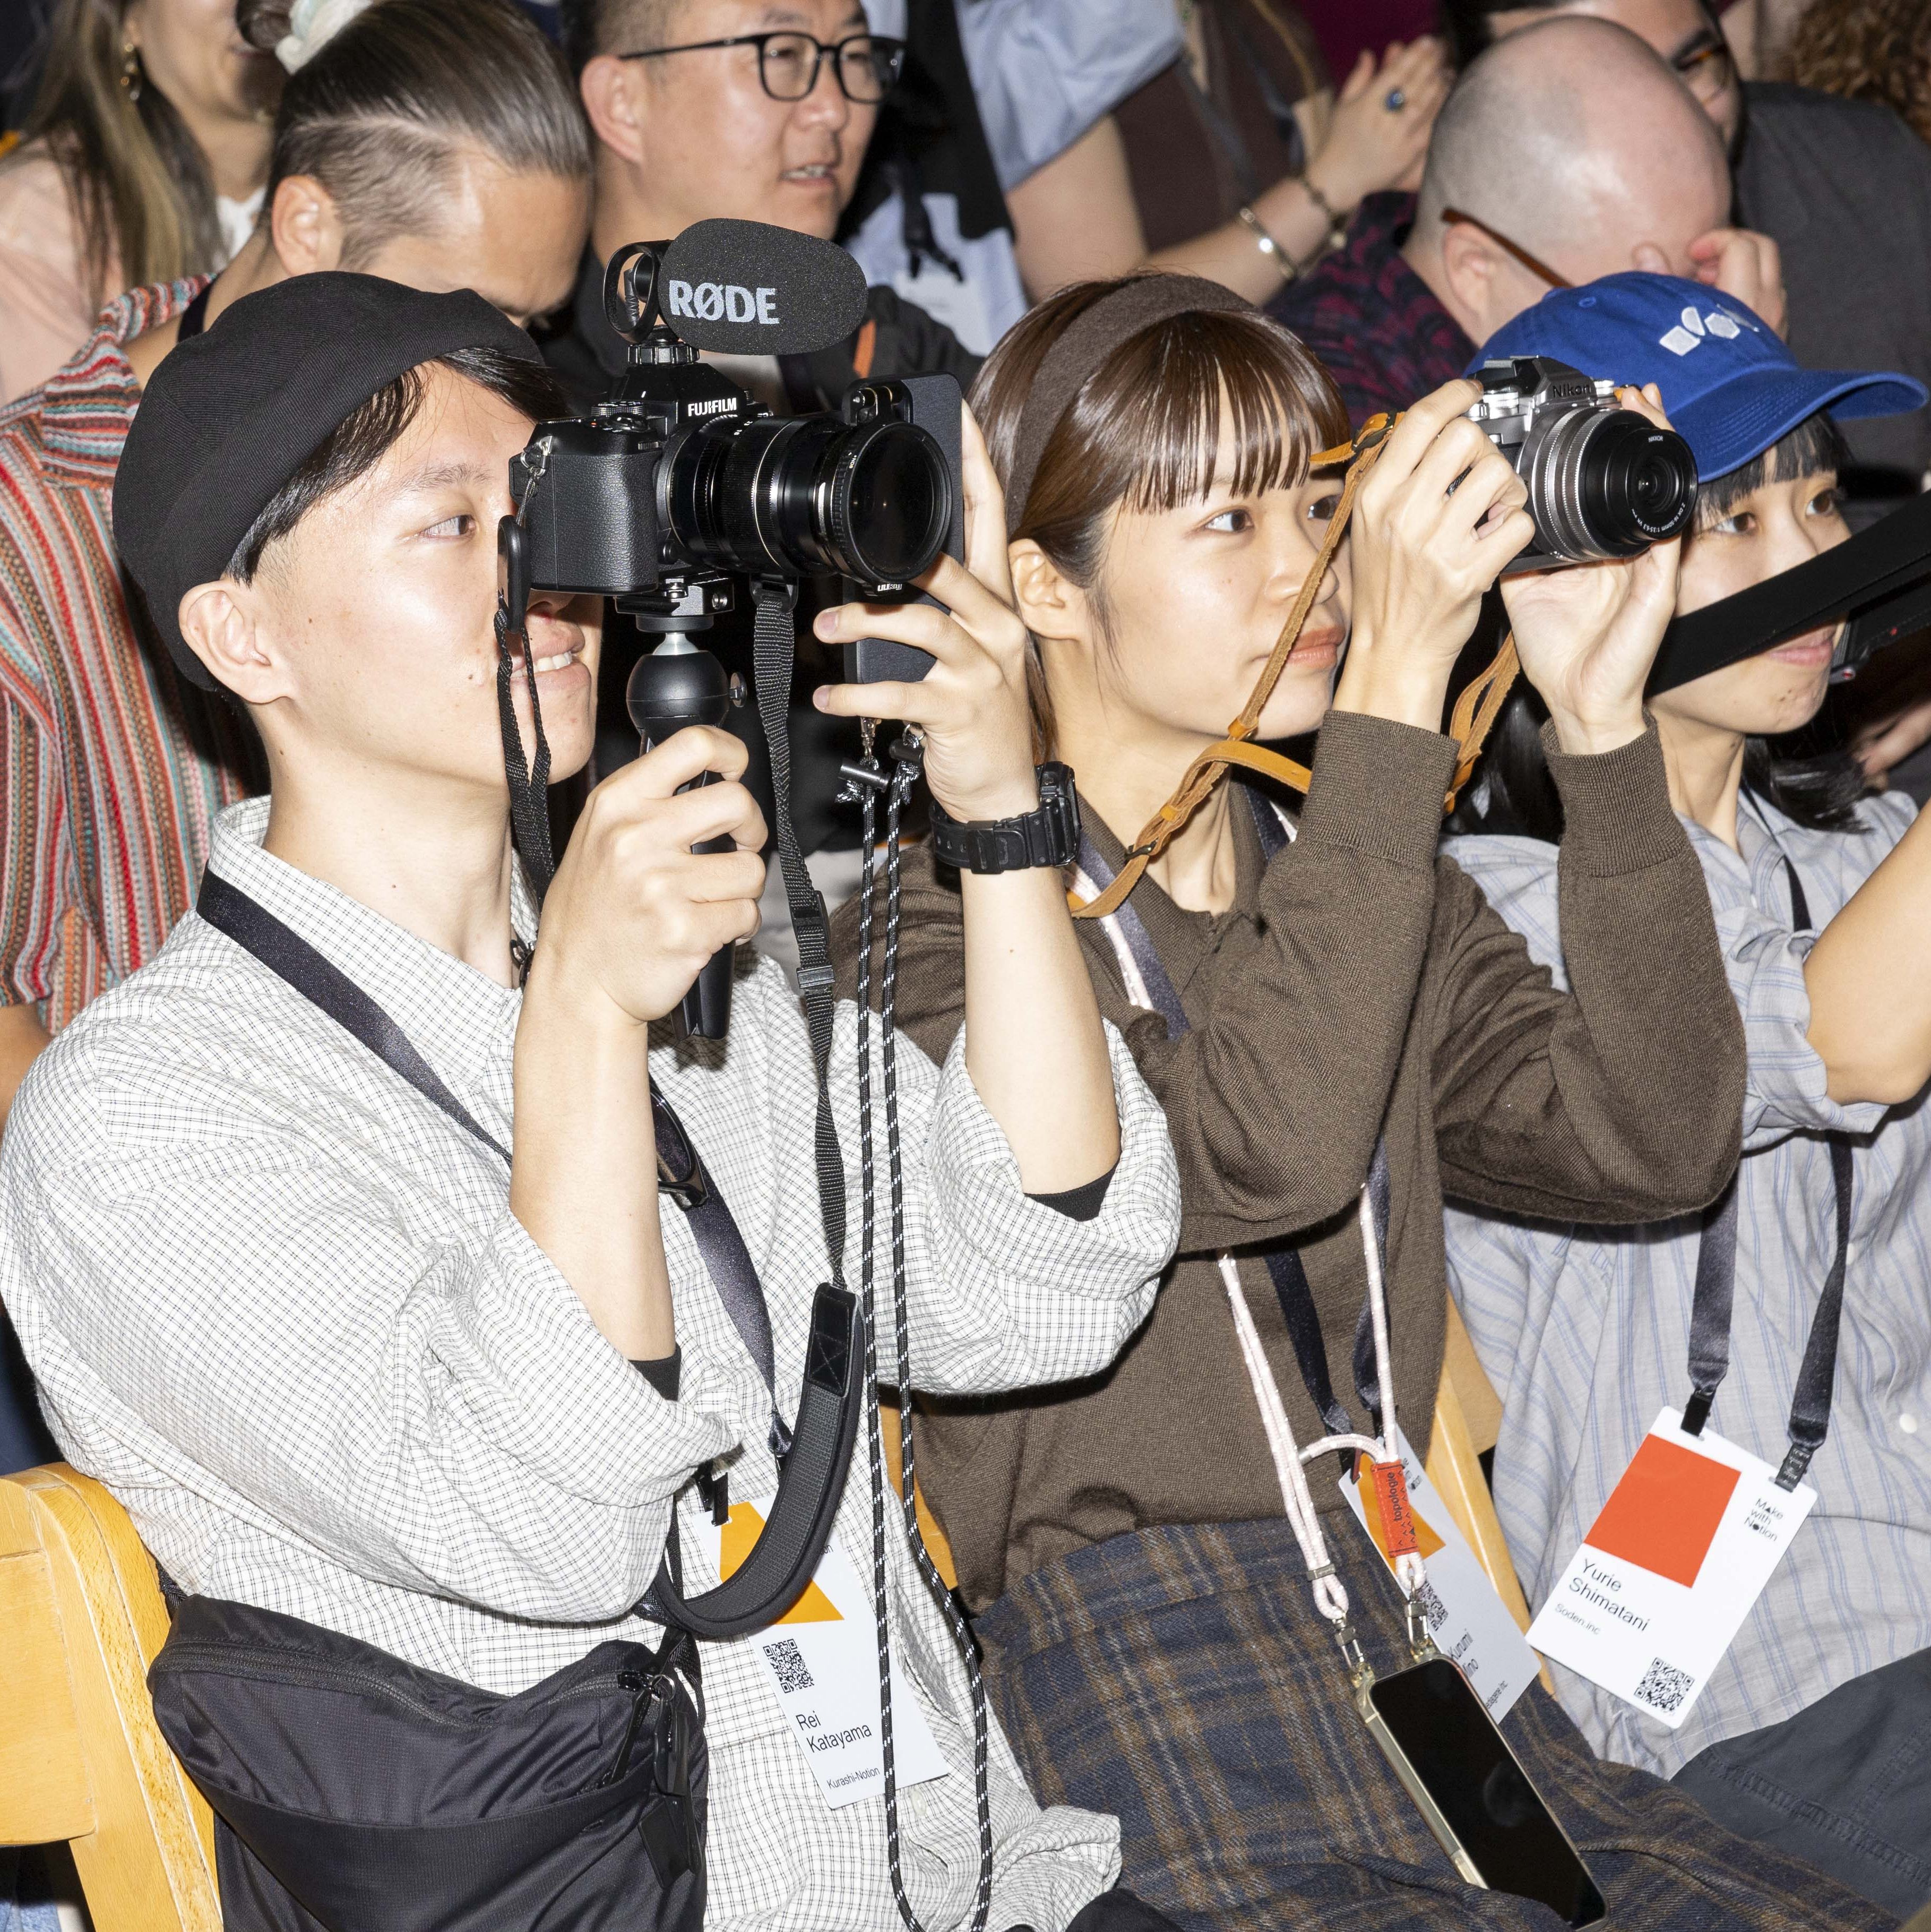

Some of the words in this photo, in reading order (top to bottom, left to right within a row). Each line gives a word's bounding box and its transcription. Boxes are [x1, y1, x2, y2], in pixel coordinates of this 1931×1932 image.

[669, 280, 780, 324] RØDE
[1551, 383, 1592, 398] Nikon
[687, 398, 737, 417] FUJIFILM
[1386, 1471, 1403, 1522] topologie
[1751, 1508, 1772, 1525] with
[1583, 1558, 1622, 1592] Yurie
[1569, 1577, 1651, 1632] Shimatani
[795, 1710, 822, 1731] Rei
[806, 1724, 872, 1754] Katayama
[826, 1766, 881, 1790] Kurashi-Notion
